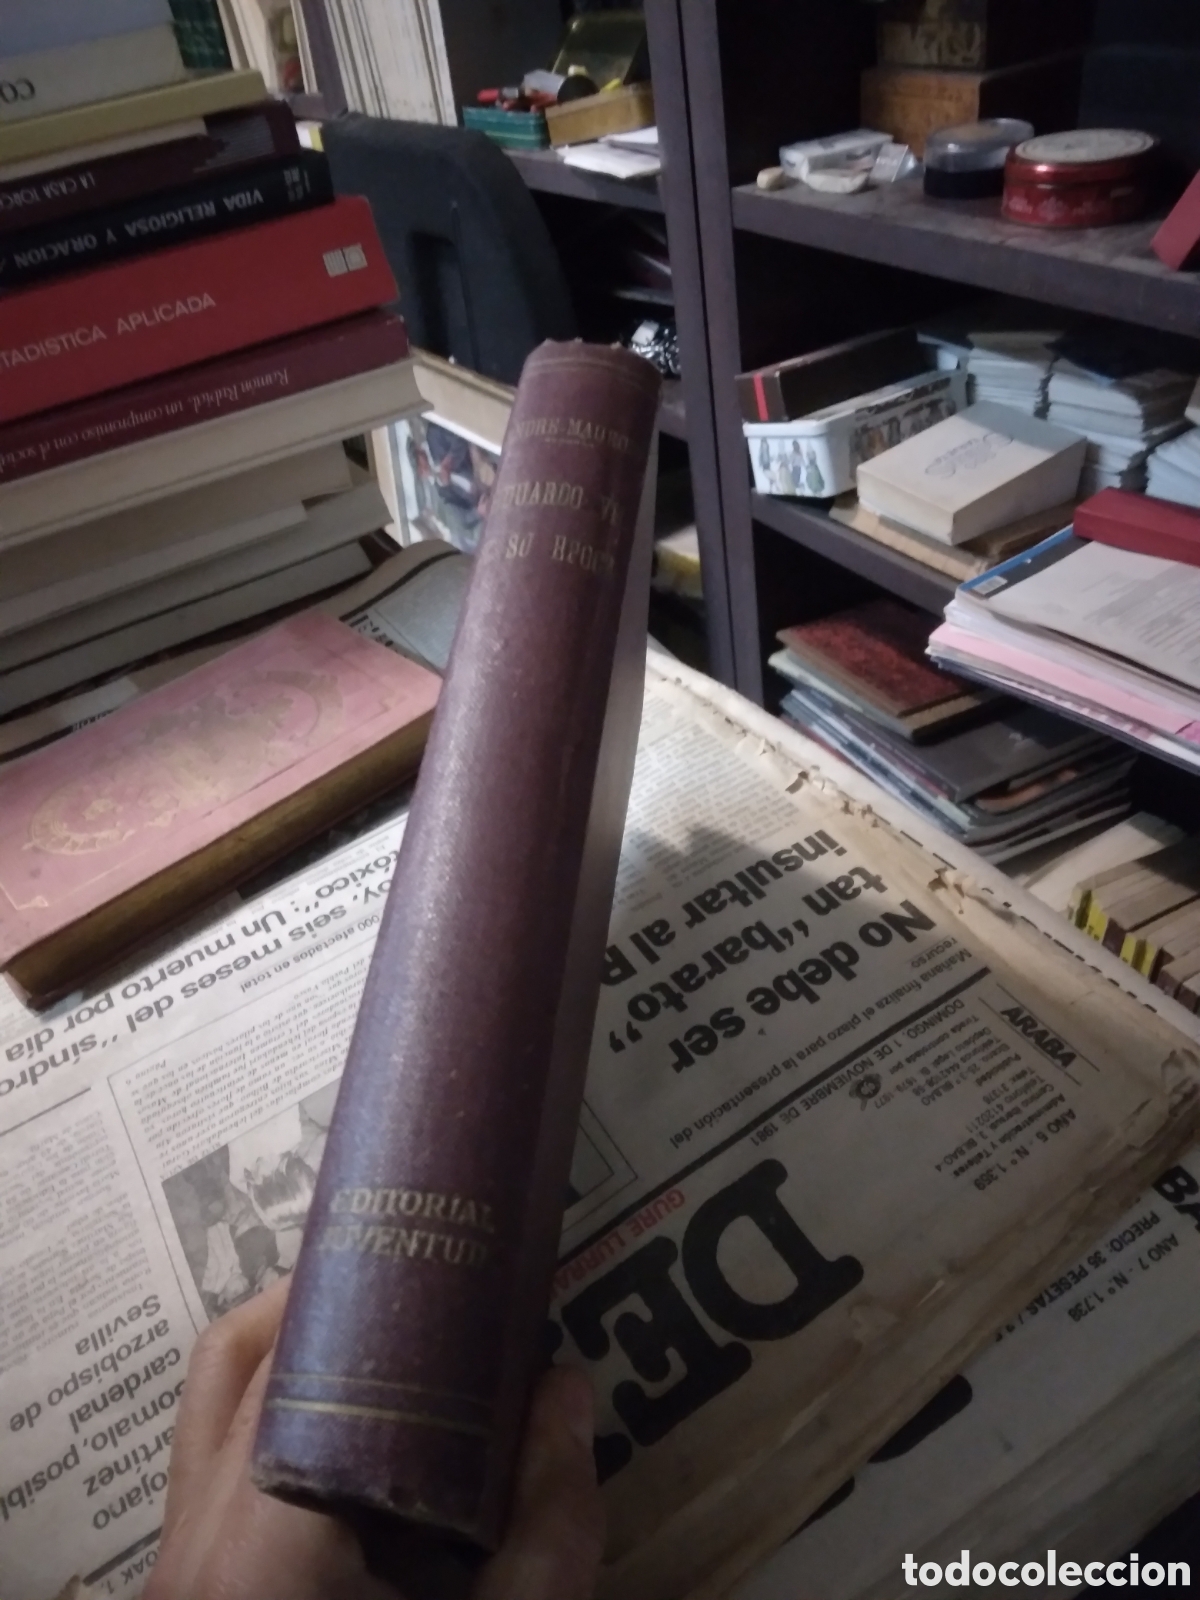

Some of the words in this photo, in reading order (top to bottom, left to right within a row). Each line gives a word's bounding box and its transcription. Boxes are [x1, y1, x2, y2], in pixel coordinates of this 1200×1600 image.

[124, 200, 217, 238] RELIGIOSA
[222, 188, 264, 213] VIDA
[13, 233, 98, 270] ORACION
[106, 228, 118, 243] Y
[116, 292, 217, 337] APLICADA
[674, 830, 840, 950] insultar
[800, 866, 889, 933] tan
[240, 910, 287, 938] Un
[287, 905, 348, 943] seis
[628, 918, 677, 966] al
[857, 901, 936, 950] No
[292, 926, 356, 964] afectados
[910, 937, 957, 970] recurso
[120, 932, 237, 1001] muerto
[180, 938, 283, 1000] meses
[239, 970, 273, 993] total
[273, 960, 291, 974] en
[745, 940, 861, 1017] debe
[919, 948, 972, 984] Mañana
[56, 991, 116, 1033] por
[125, 994, 175, 1034] del
[861, 1006, 877, 1022] el
[874, 979, 923, 1011] finaliza
[4, 1027, 56, 1063] día
[667, 1006, 747, 1075] ser
[826, 1013, 863, 1042] plazo
[1000, 1006, 1077, 1069] ARABA
[780, 1057, 799, 1071] la
[795, 1035, 828, 1062] para
[872, 1043, 895, 1062] DE
[692, 1064, 783, 1132] presentación
[799, 1057, 875, 1112] NOVIEMBRE
[778, 1105, 801, 1125] DE
[669, 1126, 694, 1151] del
[749, 1122, 780, 1148] 1981
[622, 1189, 686, 1239] GURE
[1108, 1210, 1162, 1254] PRECIO:
[1086, 1250, 1107, 1270] 35
[1137, 1256, 1150, 1271] 7
[1024, 1263, 1090, 1317] PESETAS
[74, 1294, 162, 1357] Sevilla
[46, 1318, 171, 1408] arzobispo
[68, 1347, 182, 1435] cardenal
[9, 1401, 43, 1434] de
[82, 1425, 184, 1499] artínez
[92, 1471, 175, 1531] ojano
